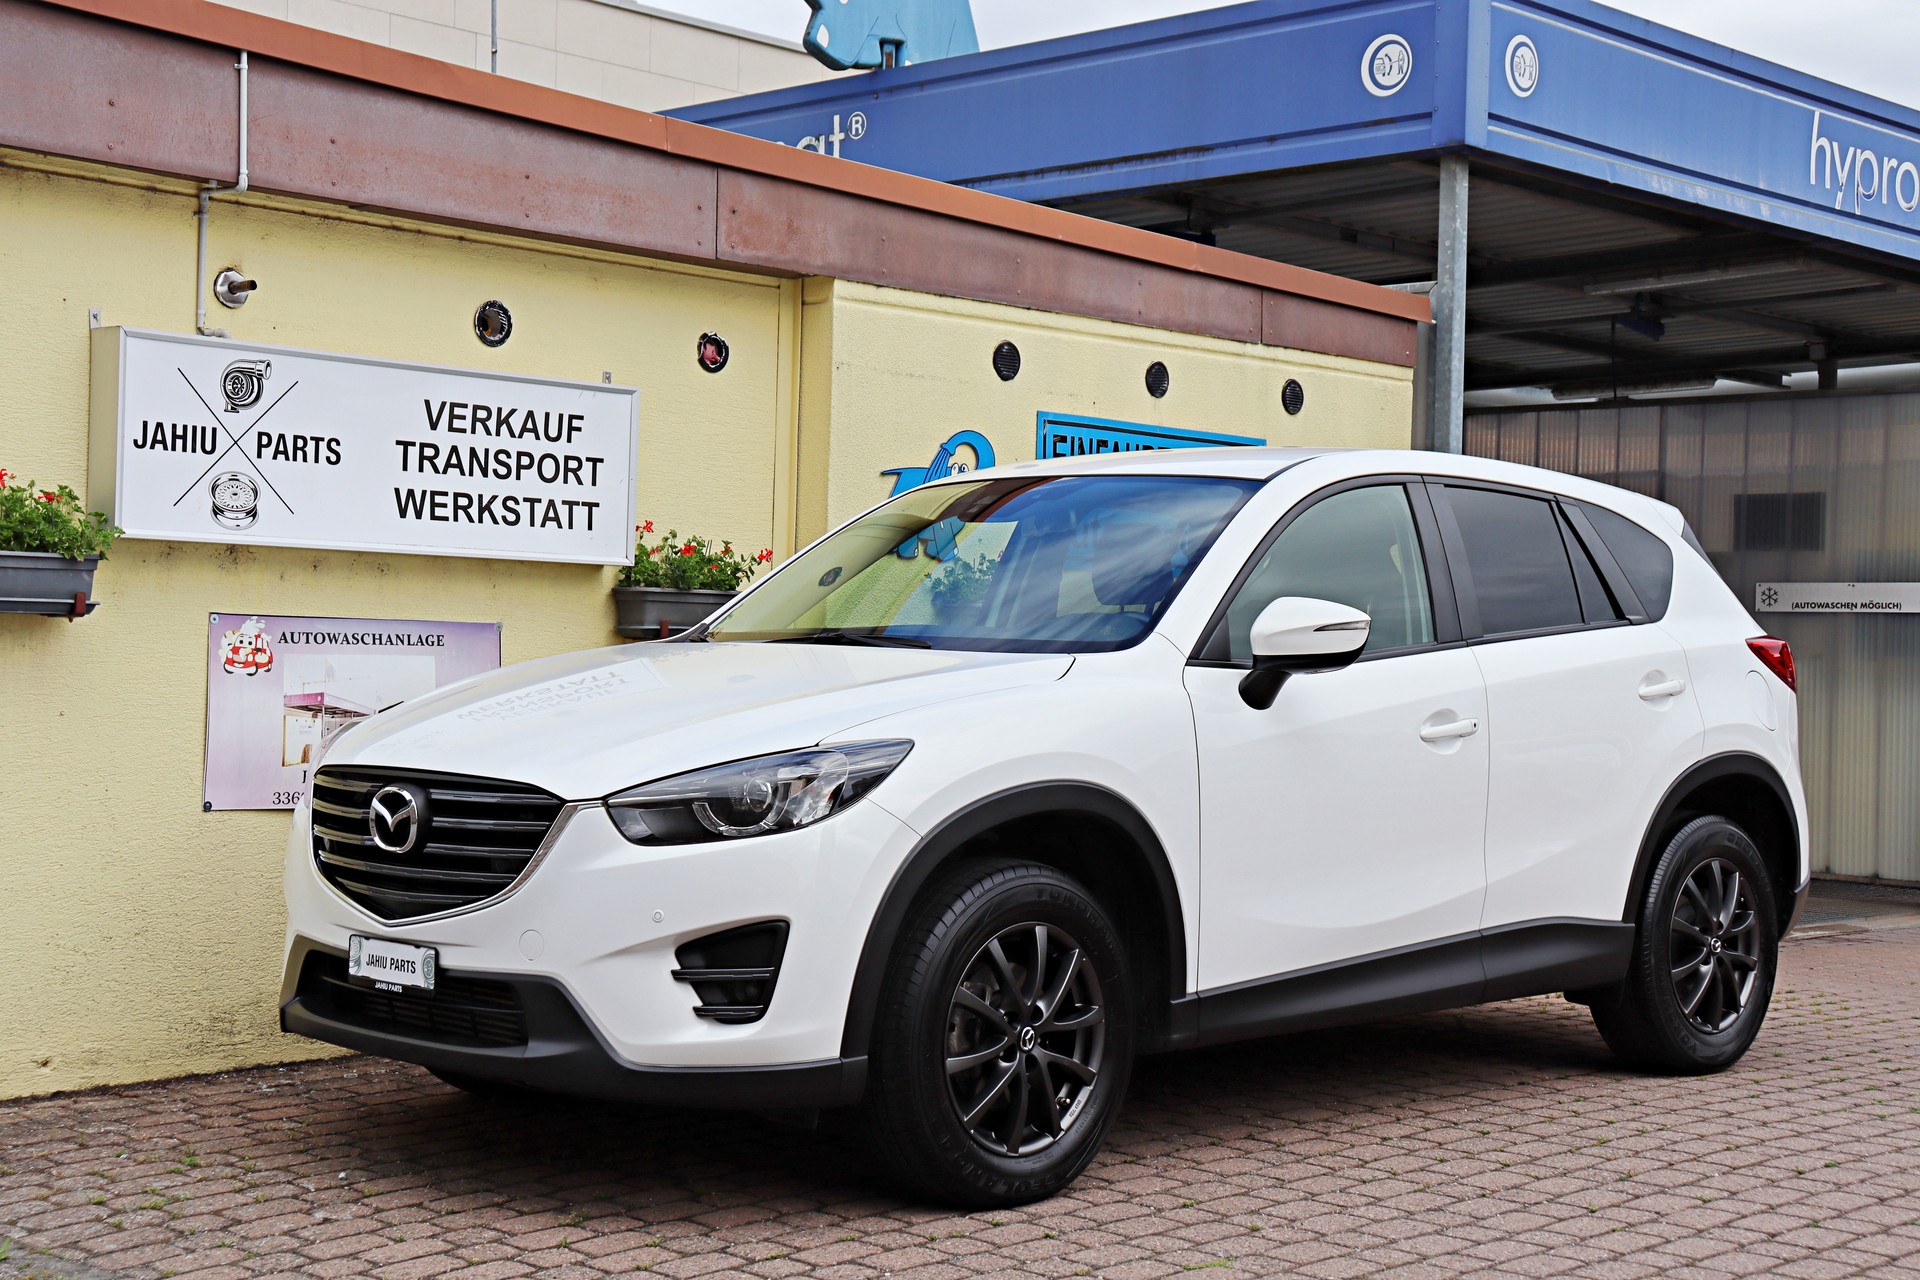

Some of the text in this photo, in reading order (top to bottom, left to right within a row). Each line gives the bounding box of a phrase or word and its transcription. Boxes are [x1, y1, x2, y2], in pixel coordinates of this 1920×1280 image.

[1809, 110, 1920, 215] hypro
[424, 399, 585, 444] VERKAUF
[133, 420, 342, 466] JAHIU PARTS
[395, 439, 605, 487] TRANSPORT
[393, 487, 600, 531] WERKSTATT
[1791, 599, 1902, 611] (AUTOWASCHEN MÖGLICH)
[278, 631, 445, 647] AUTOWASCHANLAGE
[272, 791, 304, 805] 336
[366, 954, 415, 974] JAHIU PARTS
[389, 984, 402, 993] PARTS
